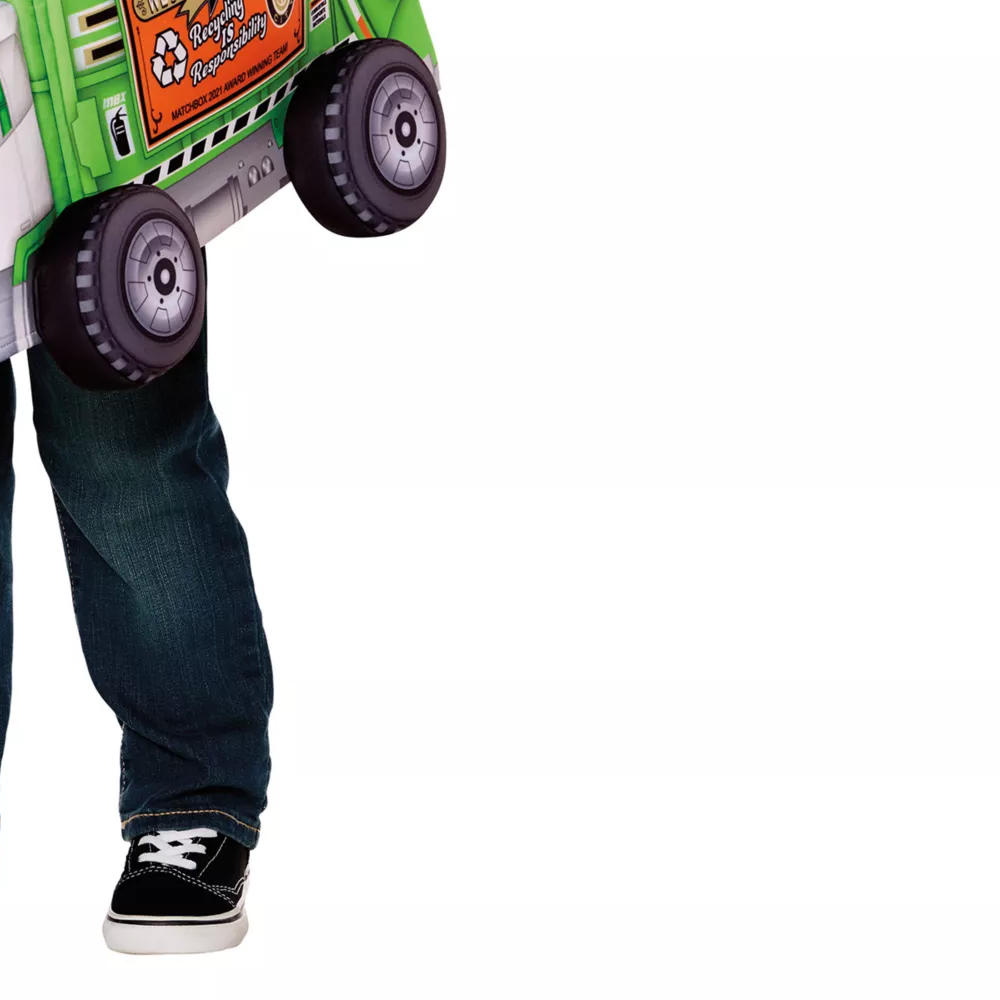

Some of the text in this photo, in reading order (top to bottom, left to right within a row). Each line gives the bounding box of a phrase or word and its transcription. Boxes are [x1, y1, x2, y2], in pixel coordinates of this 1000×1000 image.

[190, 13, 267, 86] Responsibility
[171, 94, 208, 121] MATCHBOX
[208, 87, 223, 102] 2021
[223, 72, 247, 93] AWARD
[247, 55, 273, 78] WINNING
